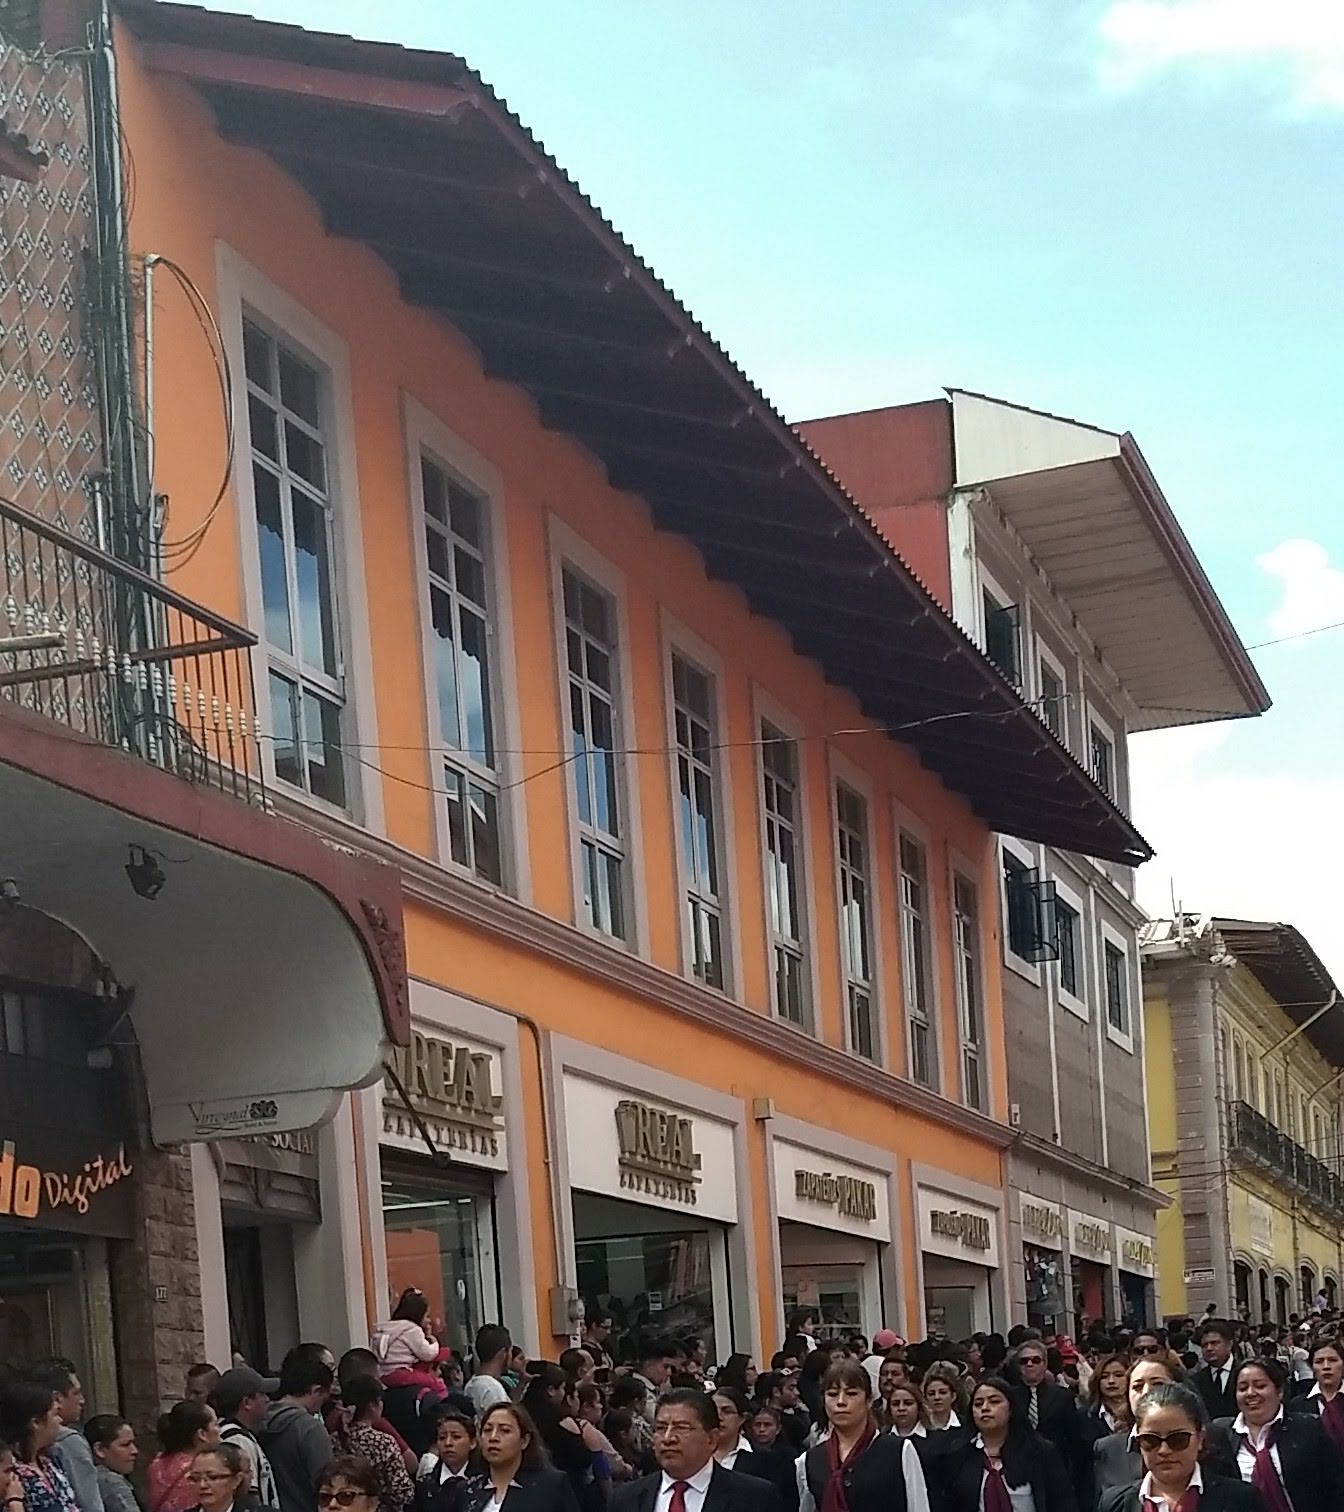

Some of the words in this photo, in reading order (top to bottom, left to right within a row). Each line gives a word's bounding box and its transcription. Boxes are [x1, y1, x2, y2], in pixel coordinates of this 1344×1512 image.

[403, 1029, 505, 1117] REAL
[634, 1101, 702, 1171] REAL
[43, 1140, 133, 1214] Digital
[836, 1175, 877, 1220] PAKAR
